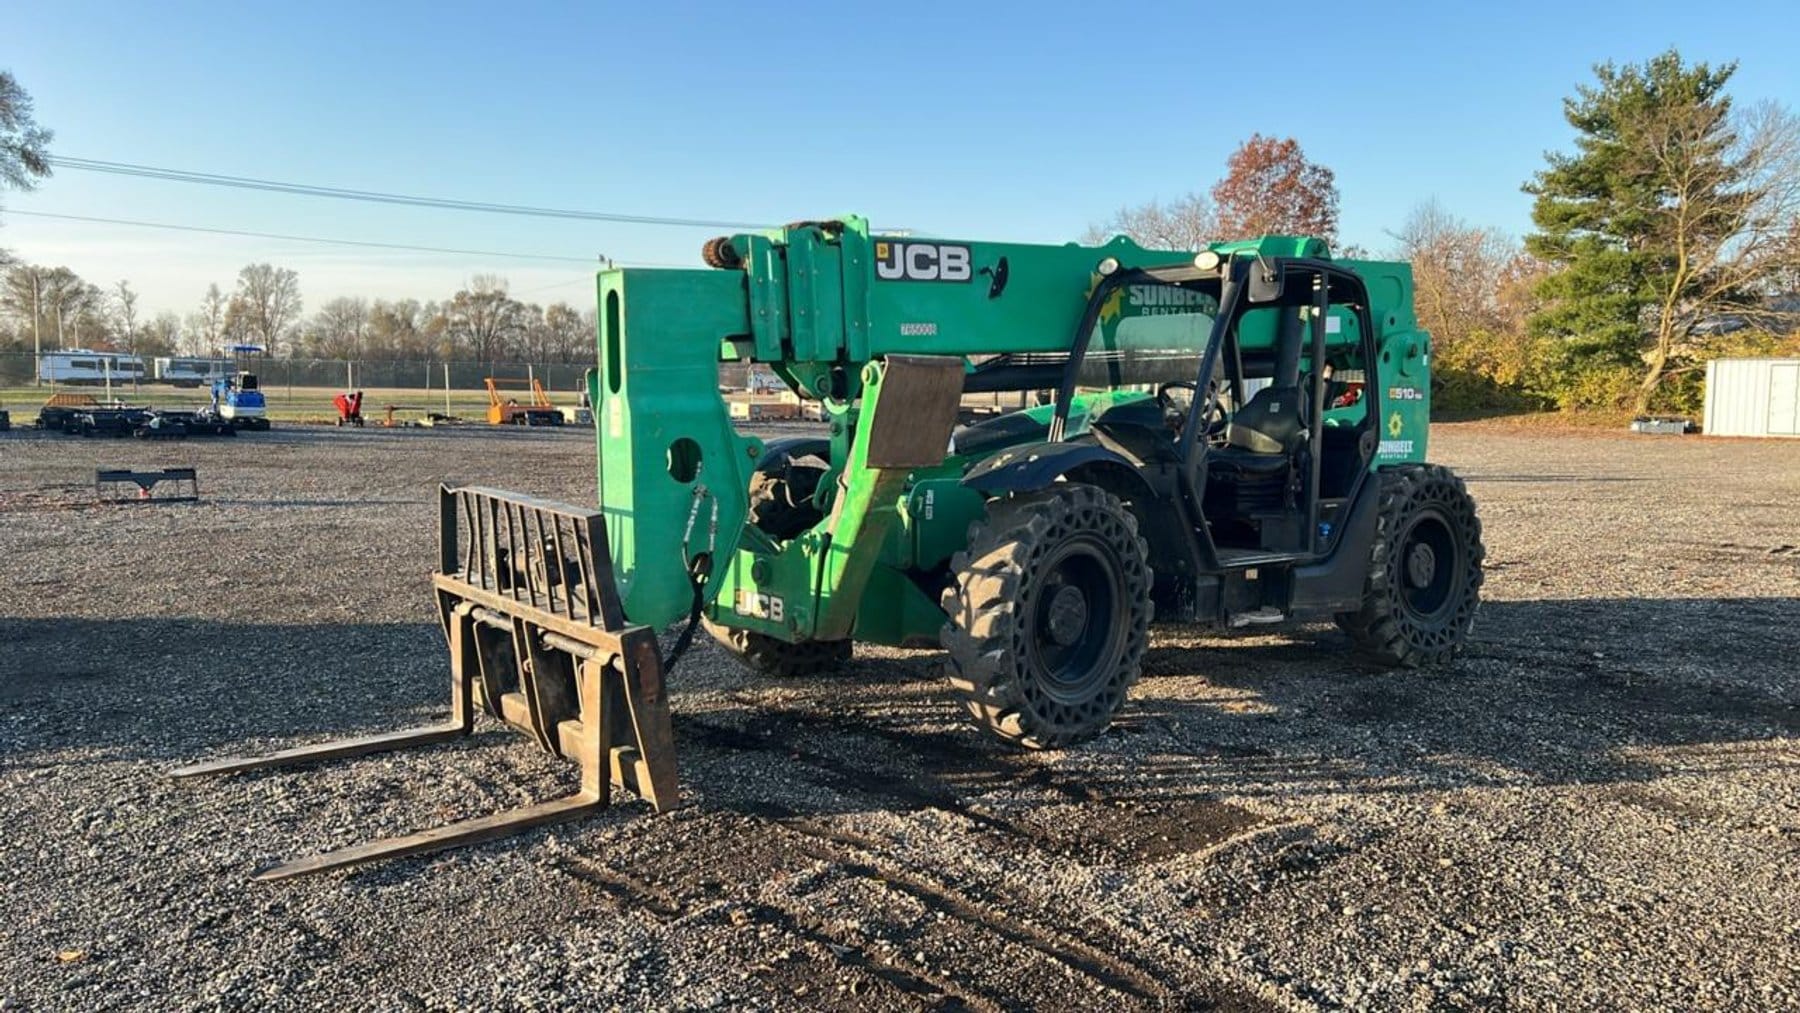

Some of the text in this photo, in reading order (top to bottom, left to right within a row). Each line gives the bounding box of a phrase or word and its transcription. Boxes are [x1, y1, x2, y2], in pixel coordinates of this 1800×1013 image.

[877, 243, 971, 280] JCB
[1396, 388, 1414, 399] 510
[736, 591, 784, 622] JCB
